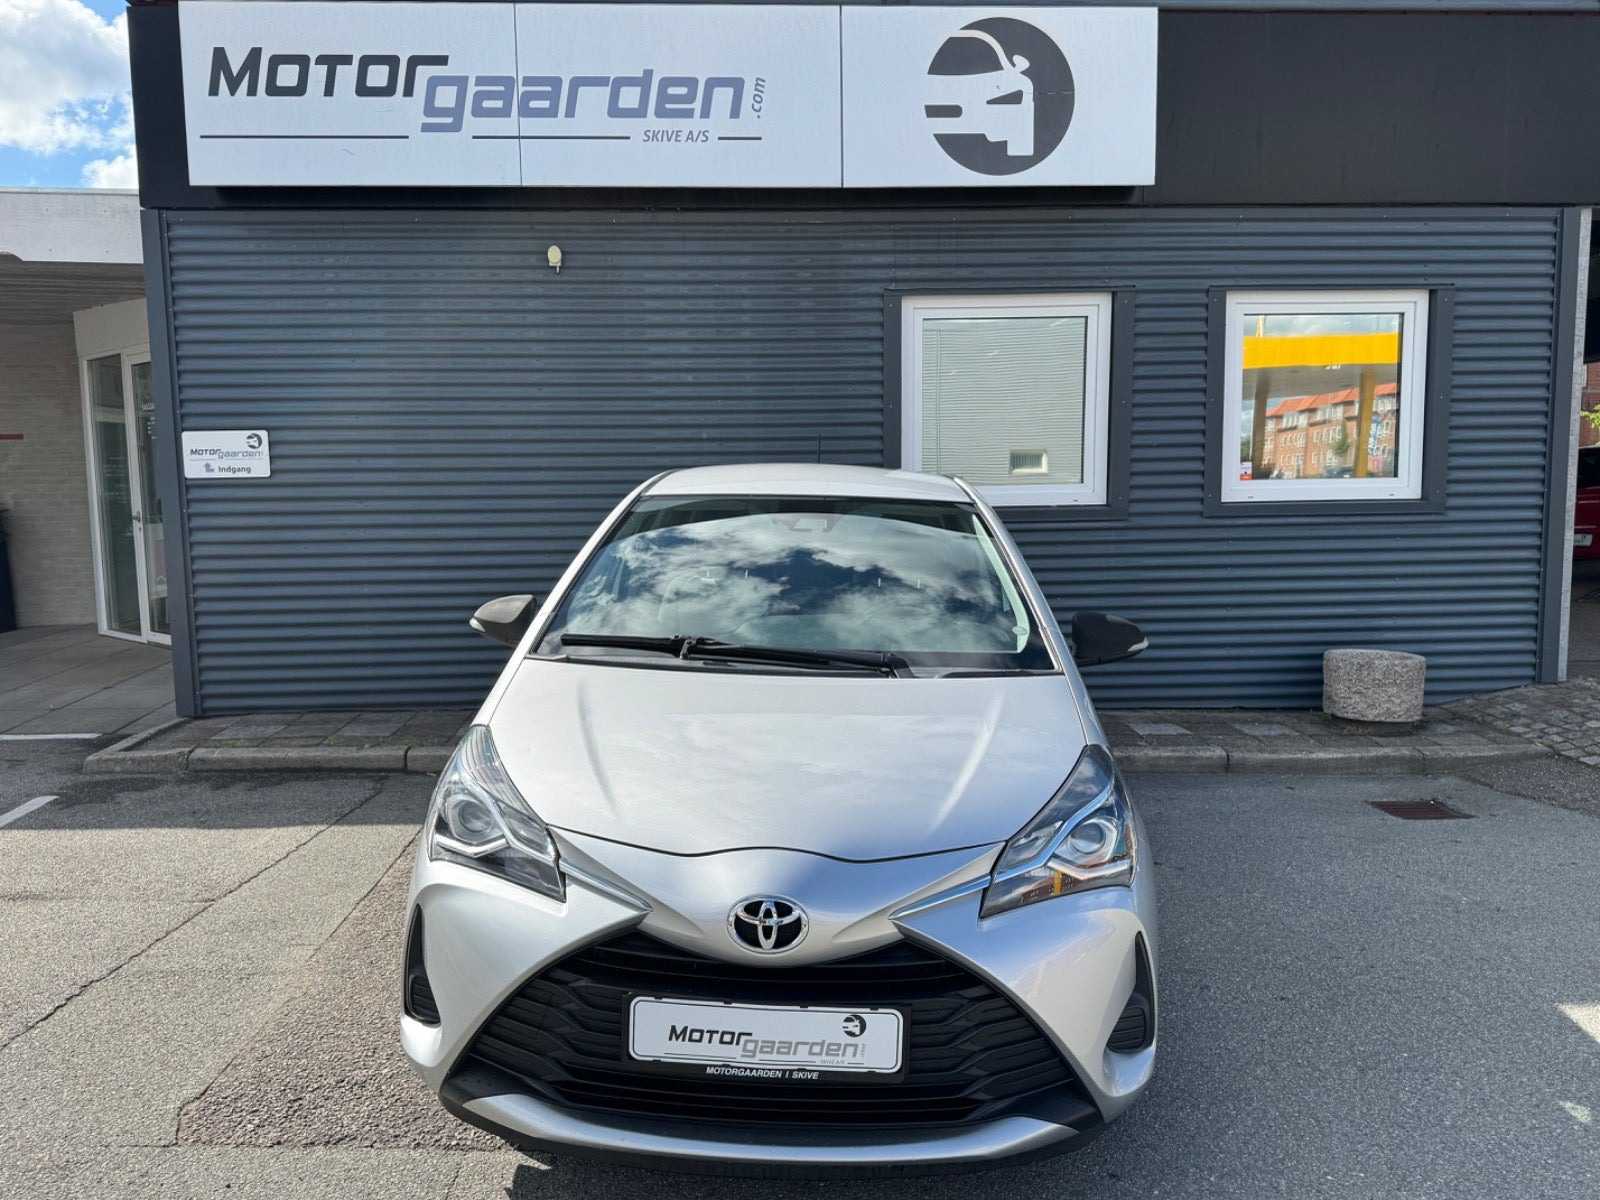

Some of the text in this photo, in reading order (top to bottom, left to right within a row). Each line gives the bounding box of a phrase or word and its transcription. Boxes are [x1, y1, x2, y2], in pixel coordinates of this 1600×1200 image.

[751, 77, 766, 119] .com
[642, 129, 710, 143] SKIVE A/S
[218, 465, 251, 473] Indgang
[706, 1066, 782, 1079] MOTORGAARDEN
[792, 1071, 819, 1080] SKIVE
